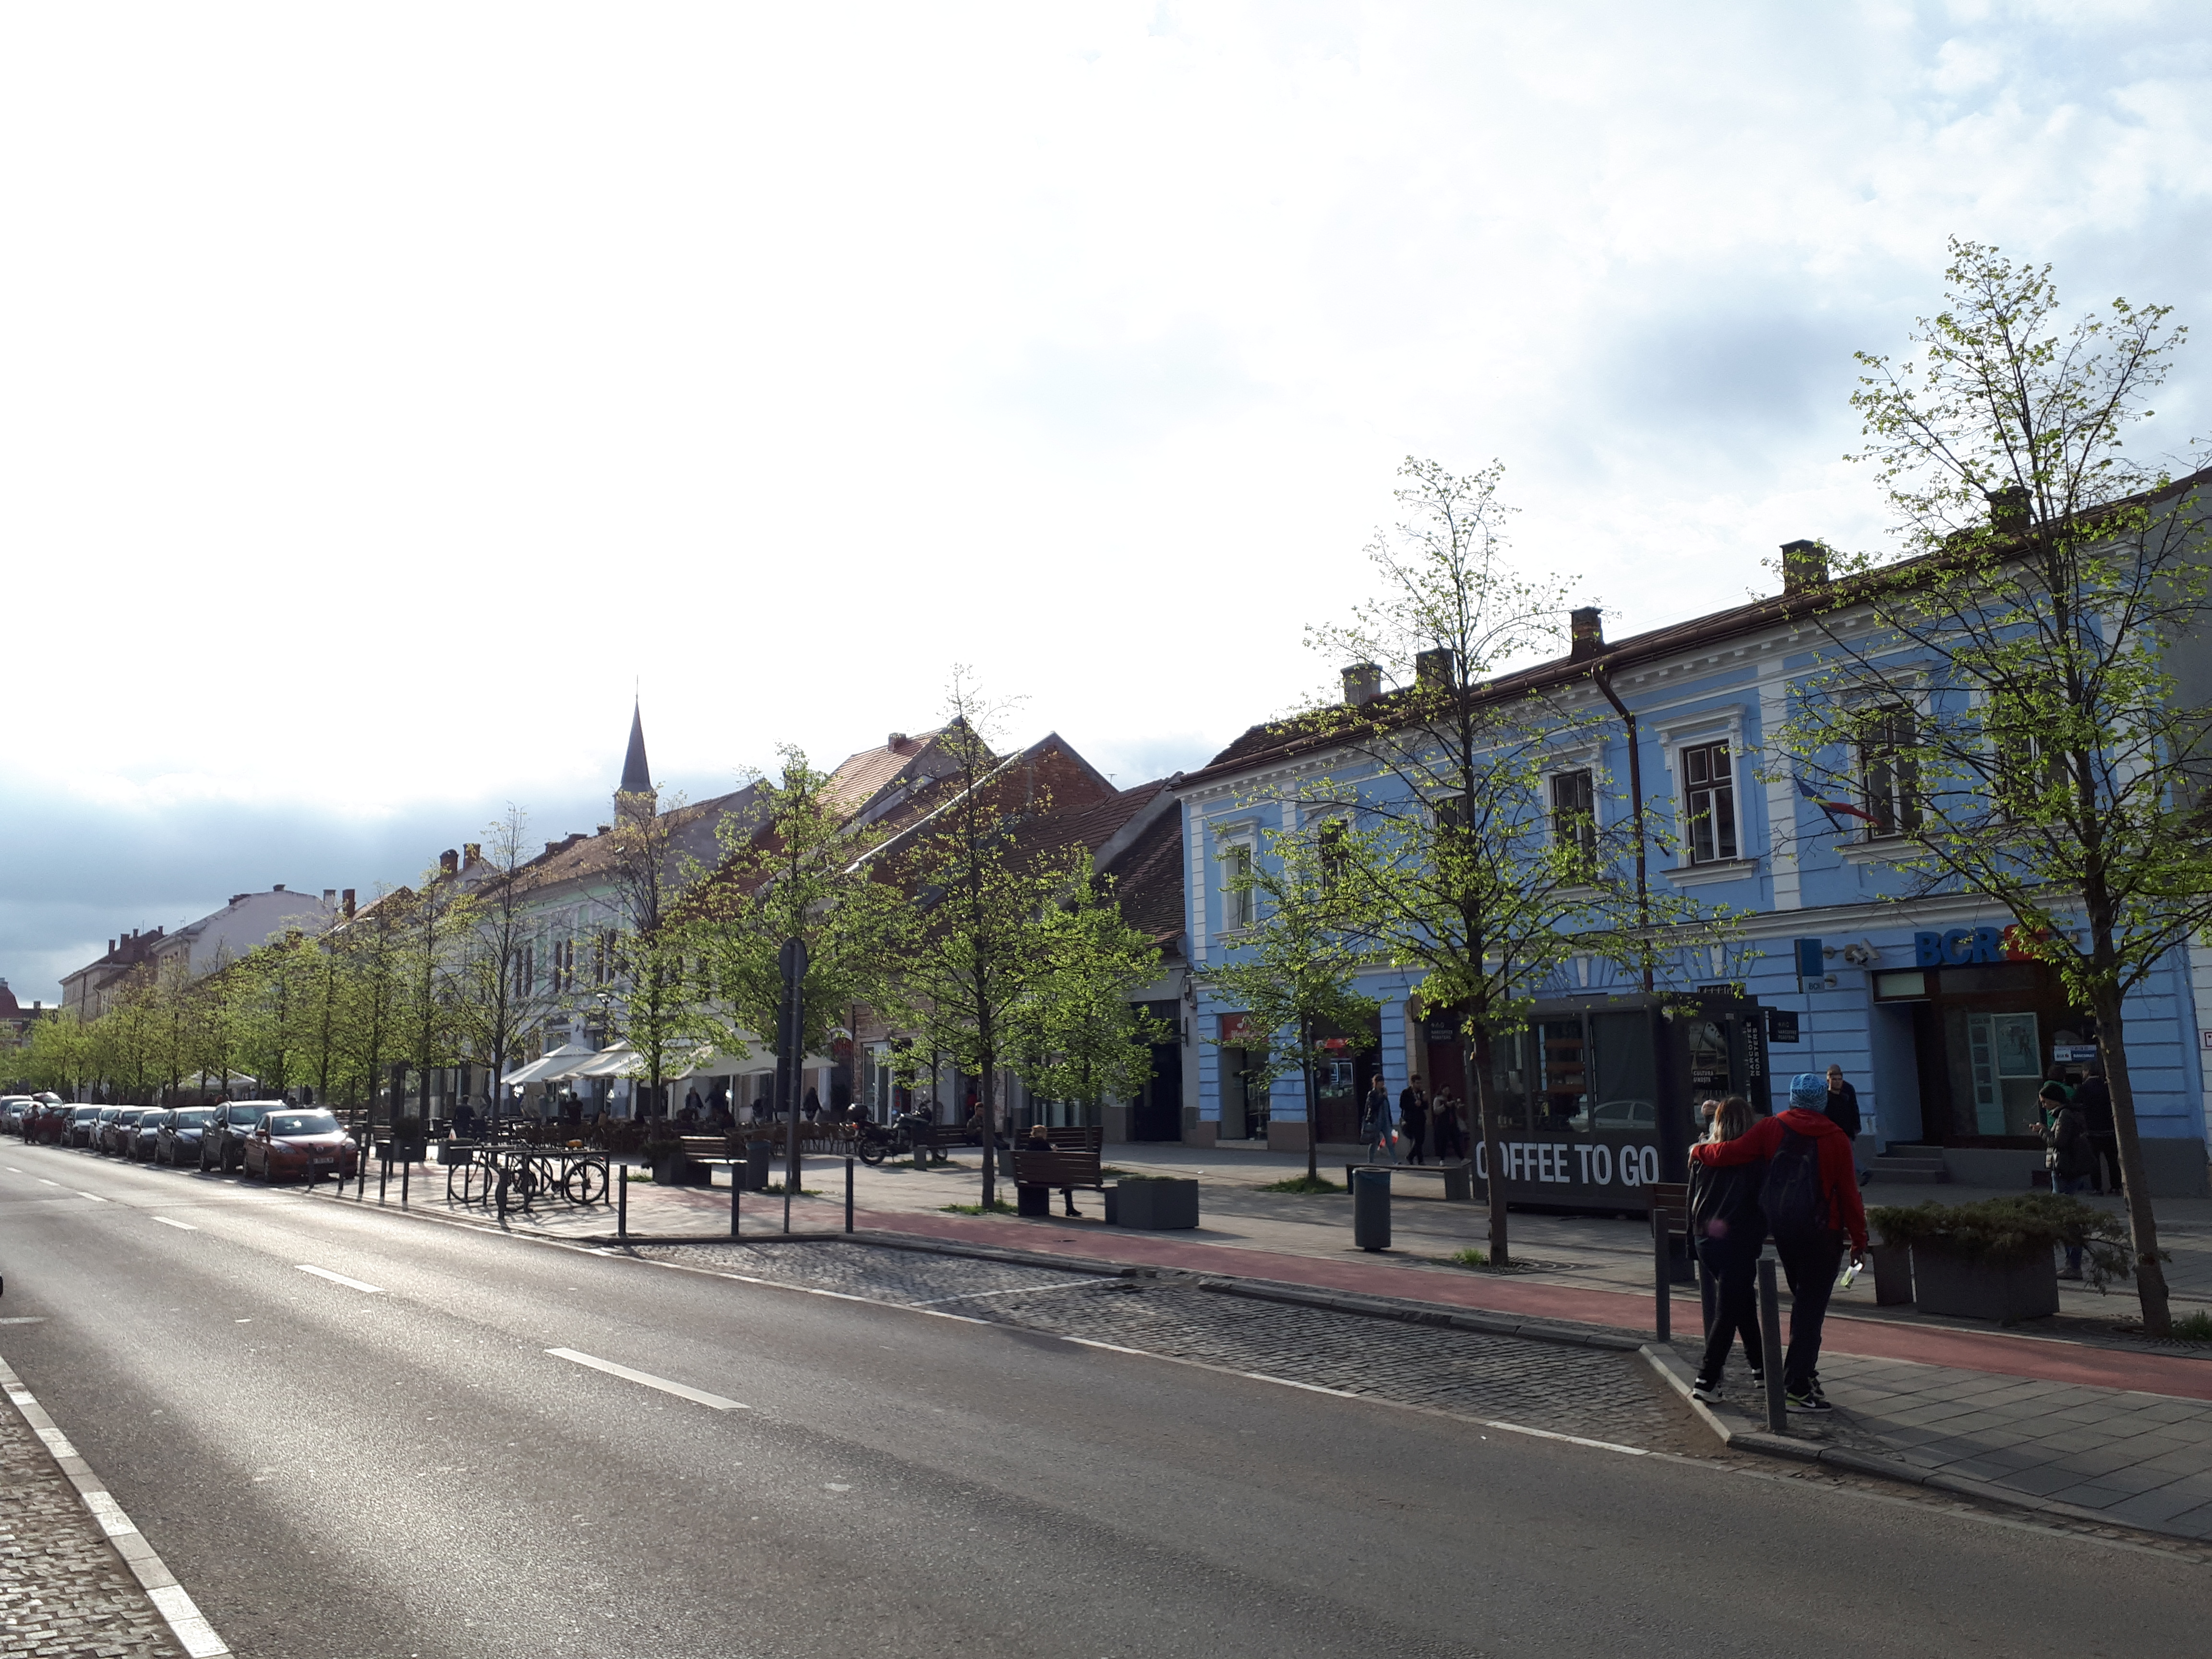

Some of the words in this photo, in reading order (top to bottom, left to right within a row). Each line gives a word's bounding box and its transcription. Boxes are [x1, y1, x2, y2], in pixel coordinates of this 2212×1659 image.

[1914, 926, 2002, 967] BCR
[1746, 1022, 1755, 1077] NARCOFFEE
[1574, 1144, 1612, 1185] TO
[1619, 1145, 1659, 1187] GO
